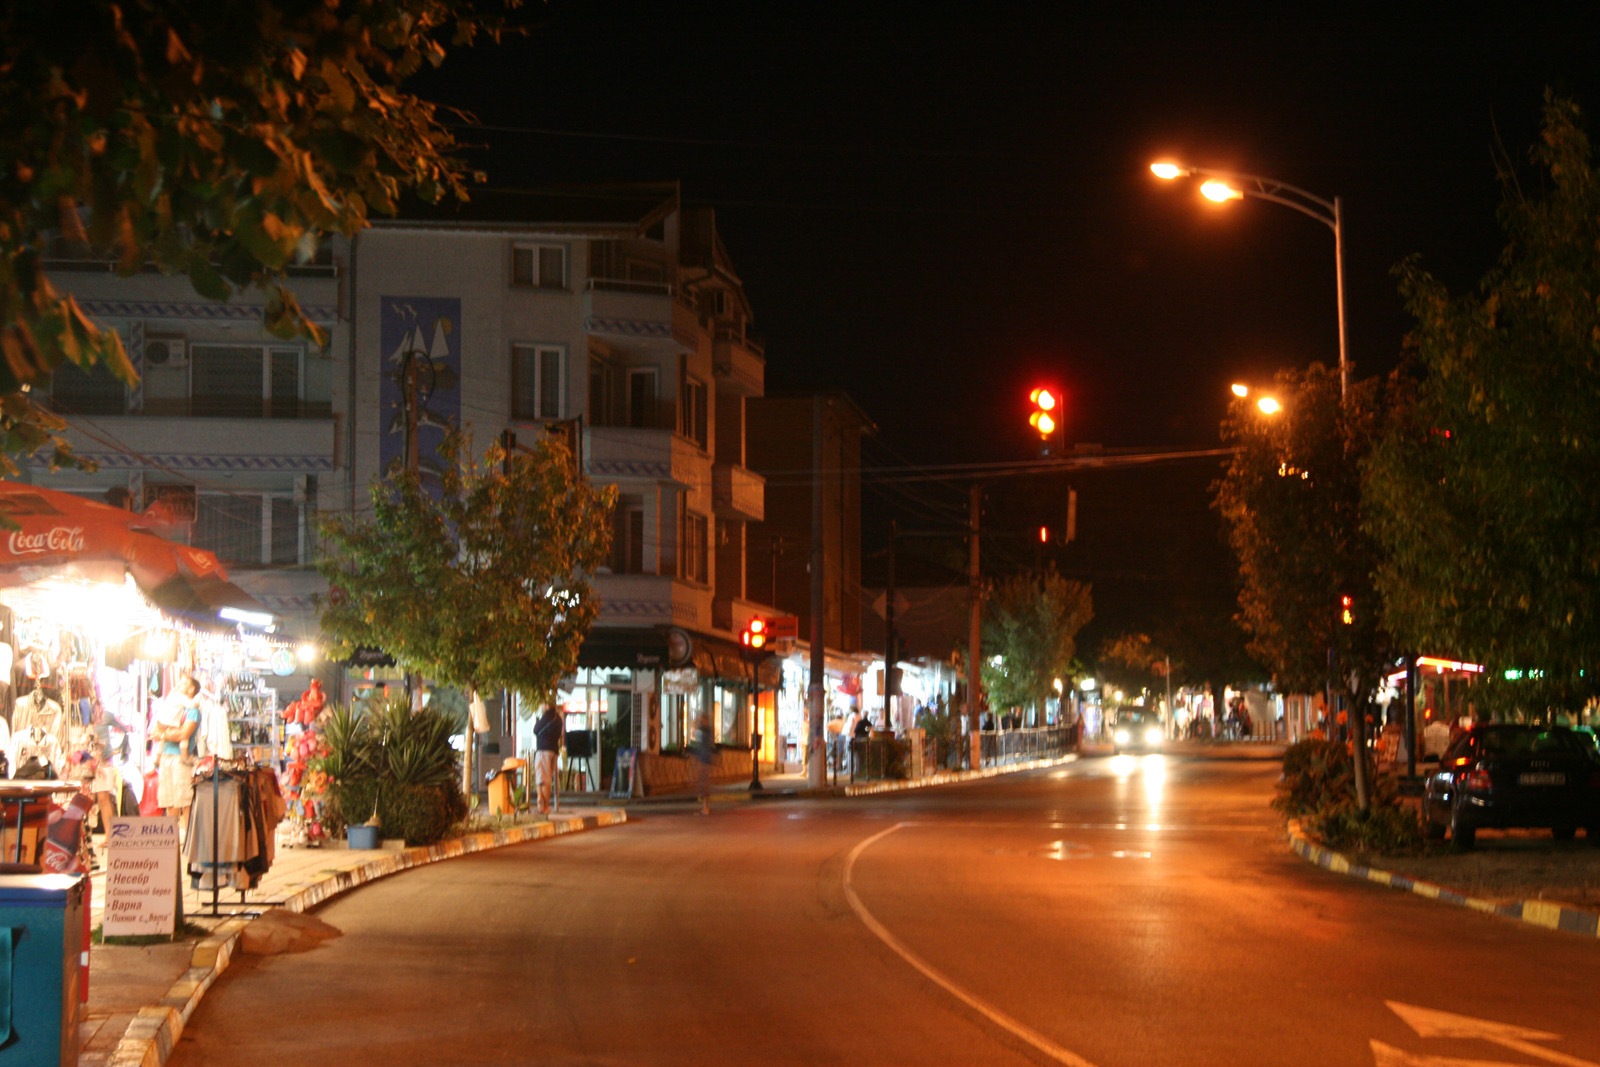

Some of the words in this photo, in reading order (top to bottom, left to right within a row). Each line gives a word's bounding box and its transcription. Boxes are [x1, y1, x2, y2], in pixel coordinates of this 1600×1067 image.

[8, 526, 86, 555] Coca-Cola
[111, 838, 175, 848] ЭКСКУРСИИ
[113, 858, 159, 872] Стамбул
[113, 872, 150, 886] Несебр
[111, 900, 143, 913] Варна
